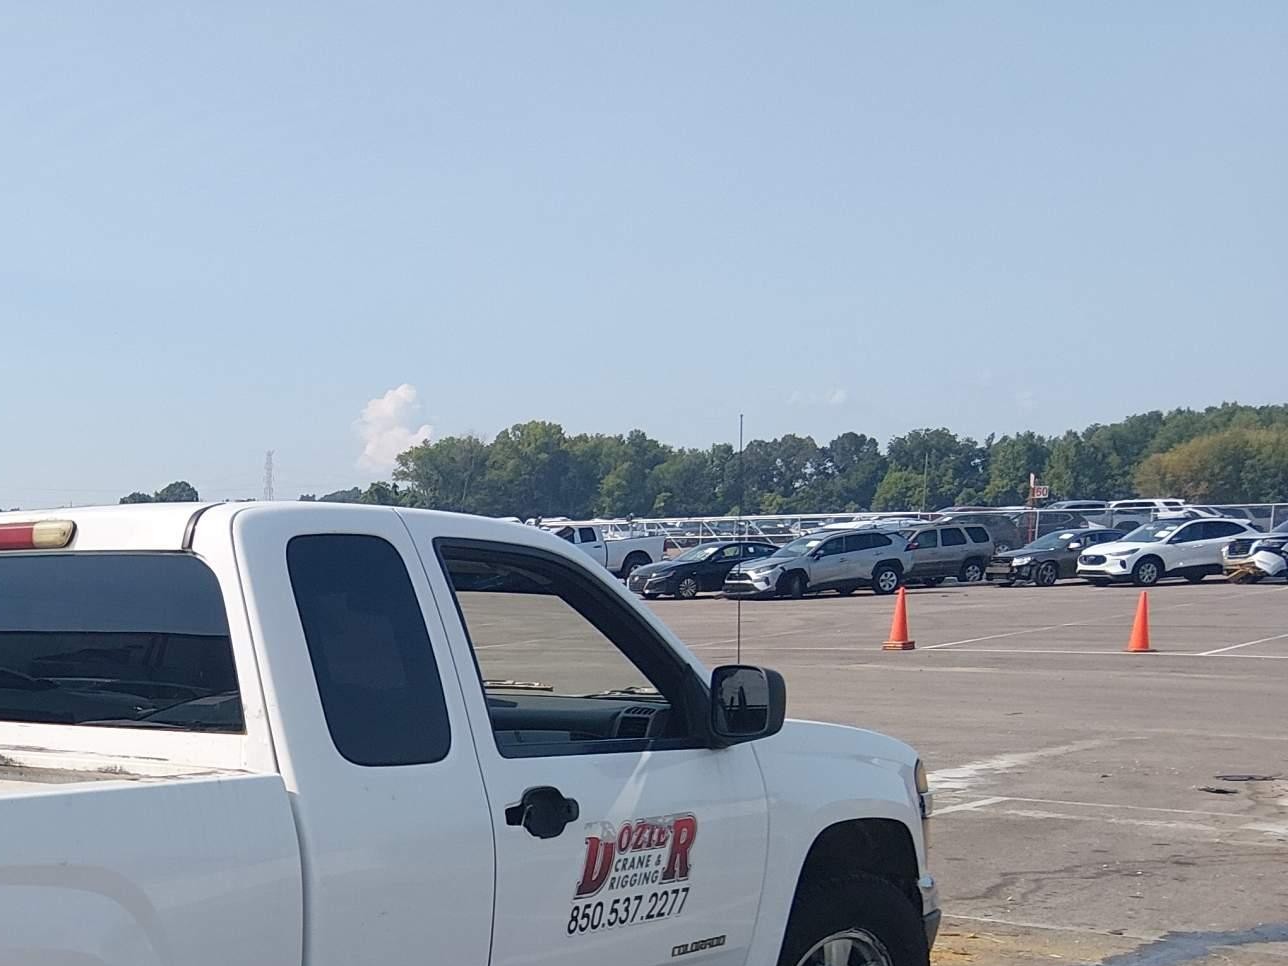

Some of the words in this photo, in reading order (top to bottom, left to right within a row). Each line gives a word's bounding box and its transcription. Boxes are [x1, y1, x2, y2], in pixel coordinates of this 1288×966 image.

[614, 854, 652, 873] CRANE
[654, 854, 662, 866] &
[608, 870, 659, 890] RIGGING
[567, 887, 690, 935] 850.537.2277
[671, 934, 727, 958] COLORADO
